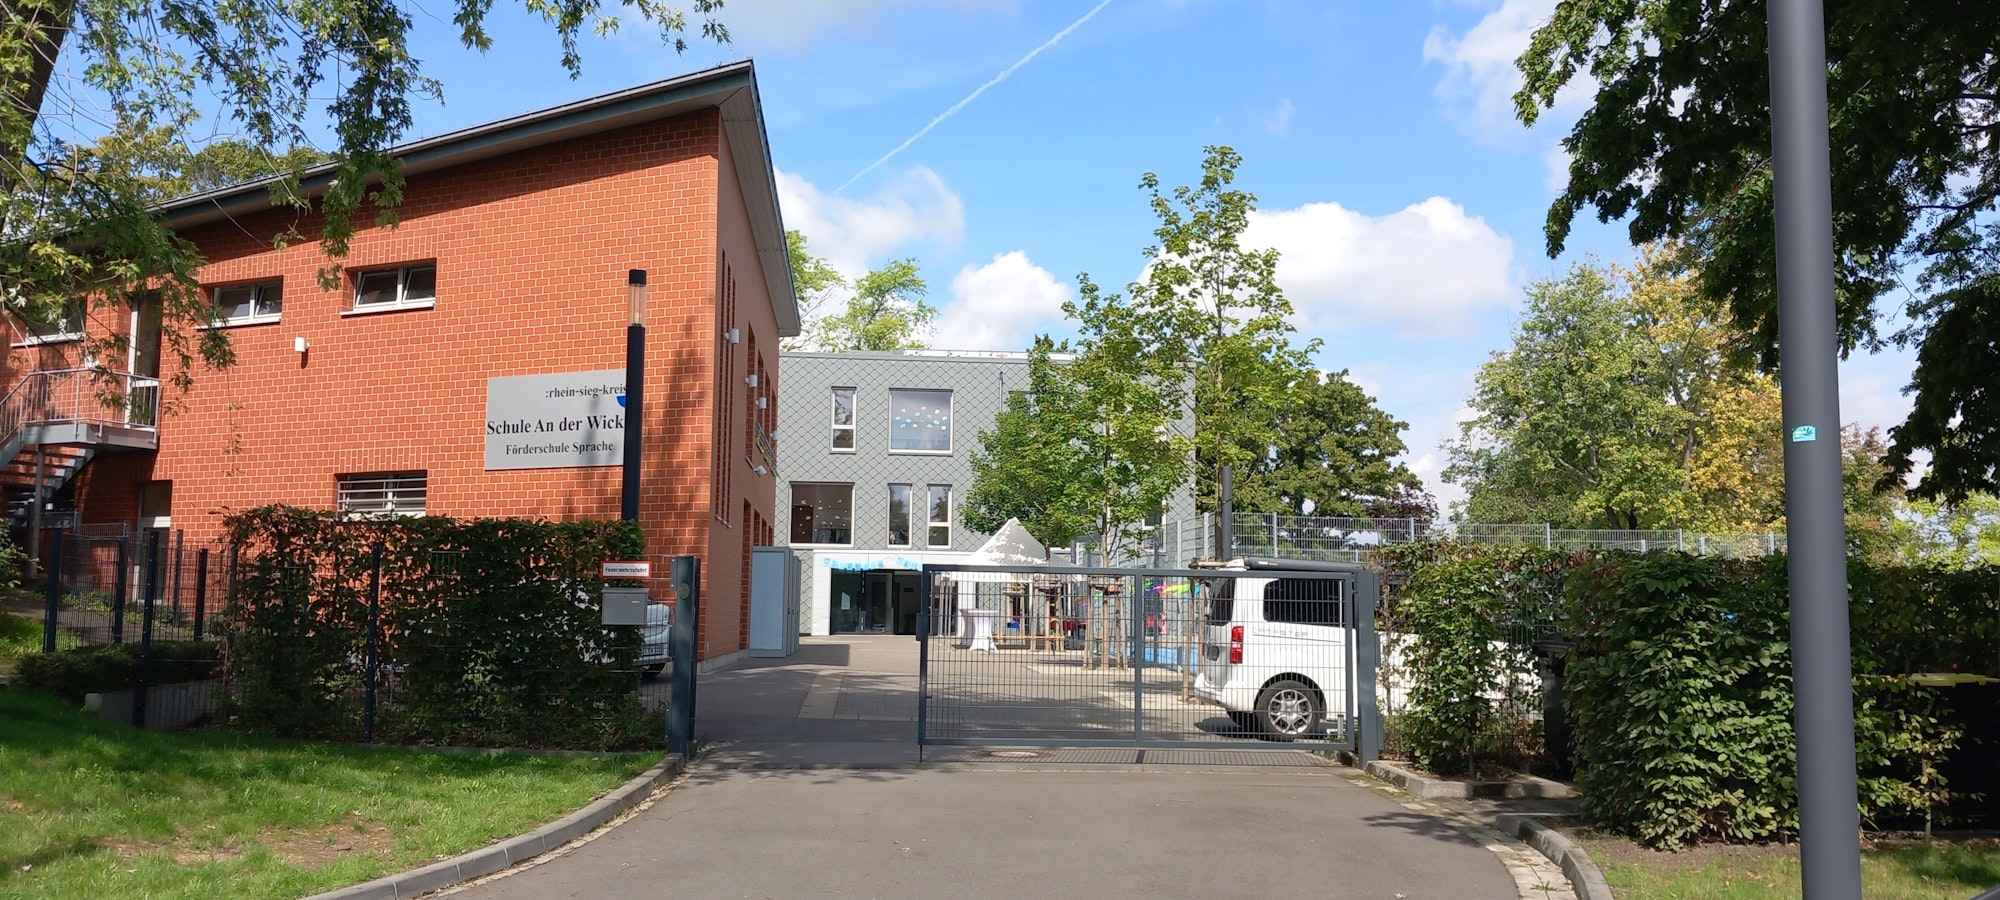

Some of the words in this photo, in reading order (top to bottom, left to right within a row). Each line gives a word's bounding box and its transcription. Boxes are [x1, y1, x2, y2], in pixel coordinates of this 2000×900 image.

[487, 418, 532, 435] Schule
[534, 418, 554, 433] An
[559, 416, 583, 431] der
[506, 442, 570, 455] Förderschule
[572, 441, 614, 455] Sprache
